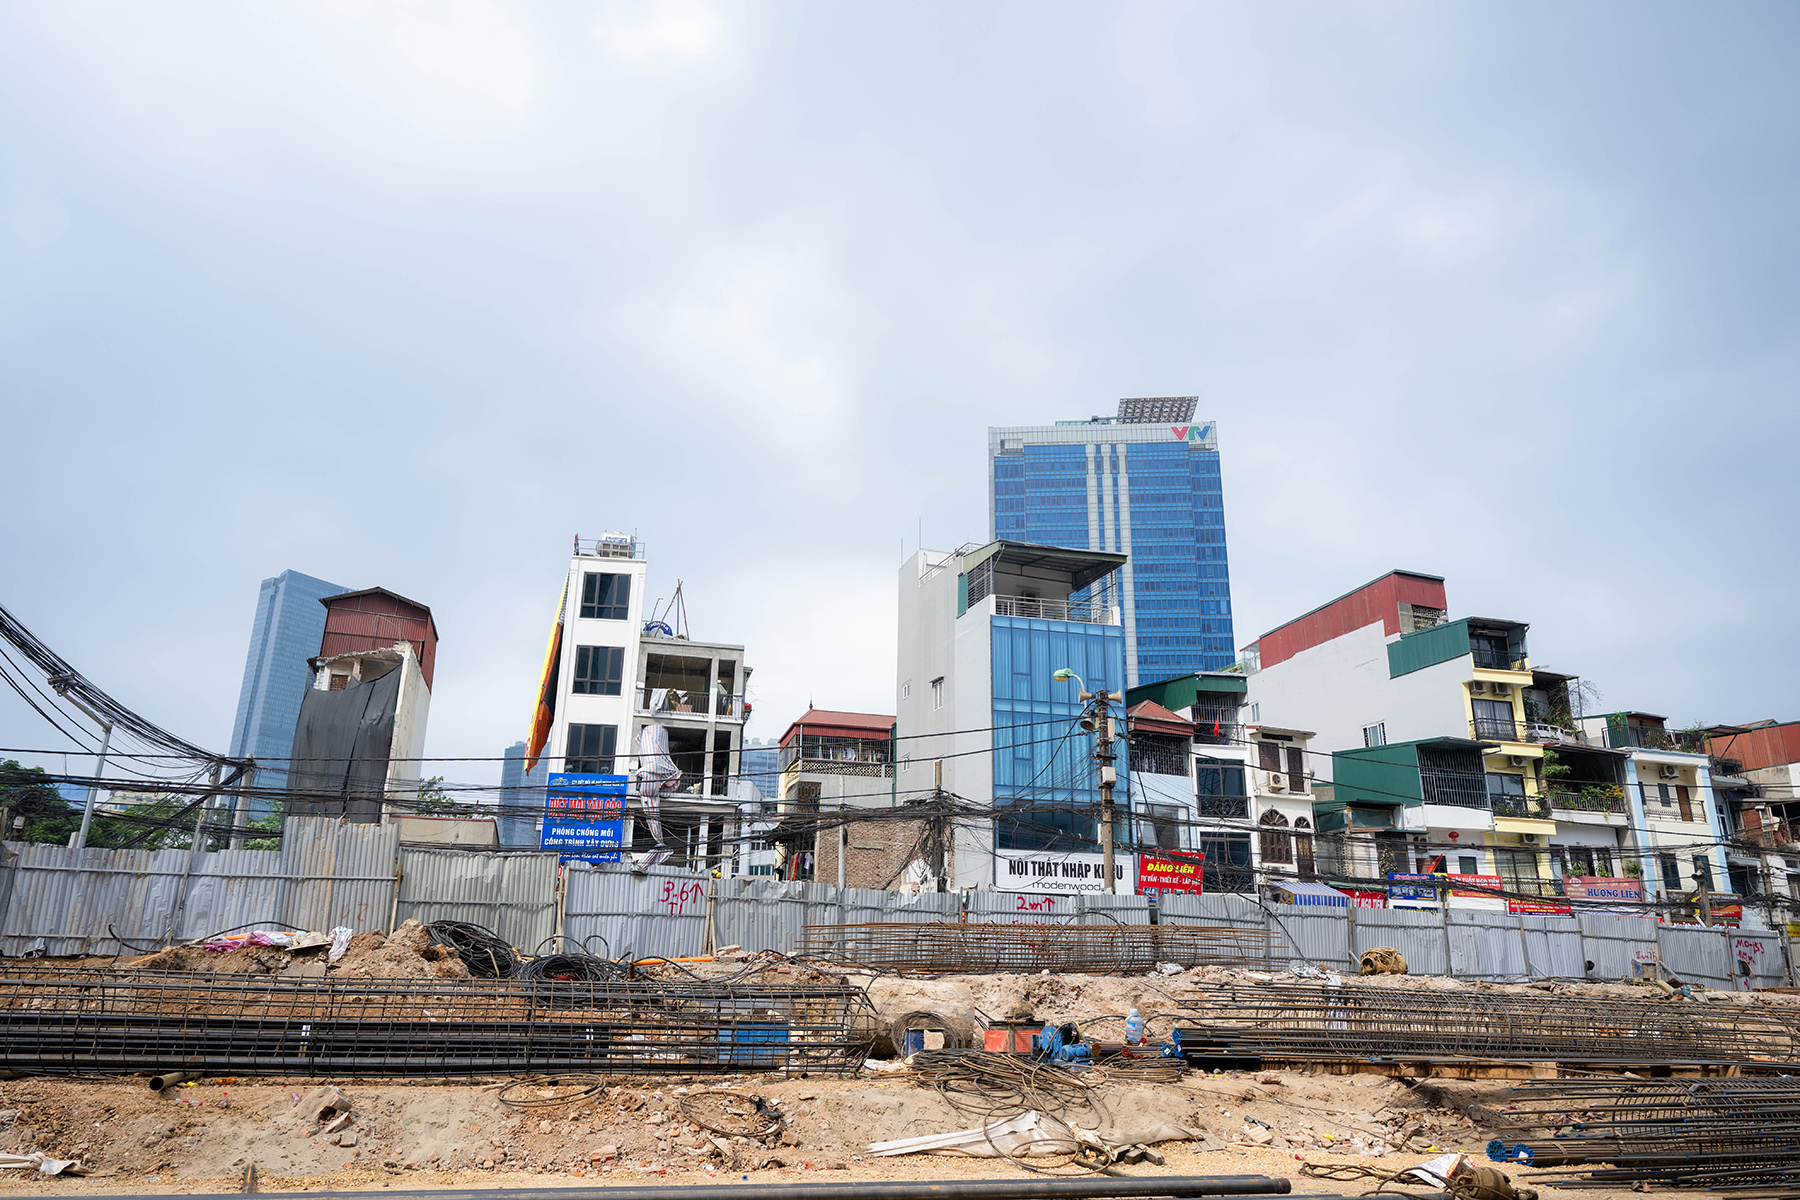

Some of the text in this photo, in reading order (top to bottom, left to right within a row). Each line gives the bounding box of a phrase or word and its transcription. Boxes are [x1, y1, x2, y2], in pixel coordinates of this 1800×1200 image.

[1170, 425, 1211, 441] VTV
[551, 826, 614, 837] PHÒNG CHỐNG MỐI
[544, 837, 563, 846] CÔNG
[564, 838, 585, 847] TRÌNH
[585, 838, 599, 847] XÂY
[1008, 857, 1028, 879] NỘI
[1031, 856, 1059, 878] THẤT
[1062, 860, 1091, 881] NHẬP
[1147, 861, 1195, 874] ĐĂNG LIÊN
[1587, 887, 1641, 899] HƯƠNG LIÊN
